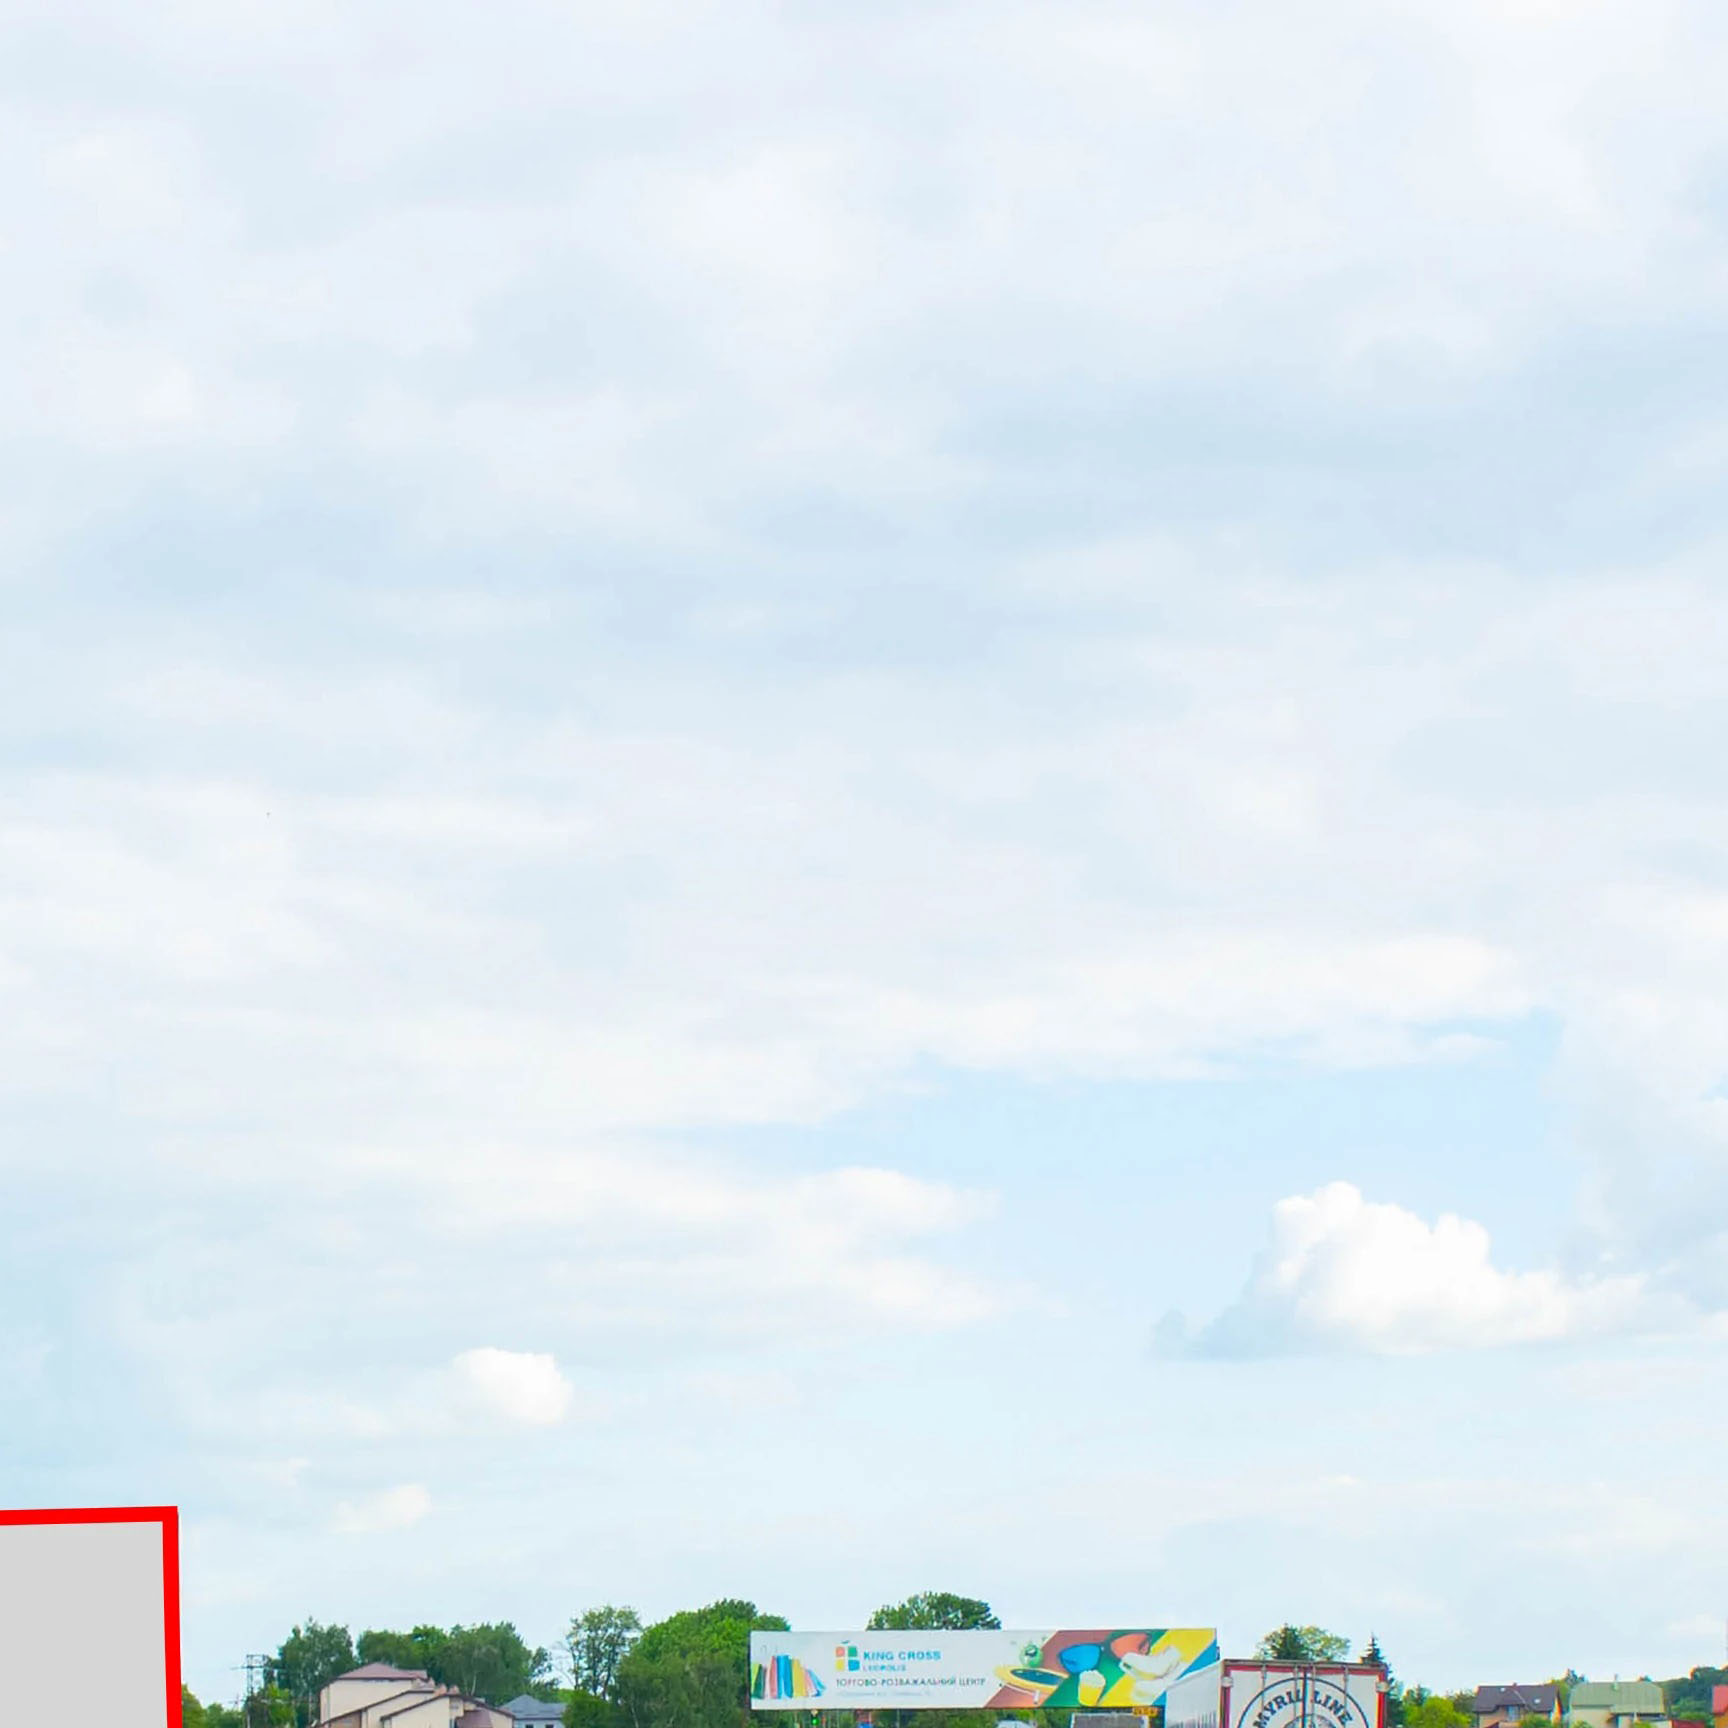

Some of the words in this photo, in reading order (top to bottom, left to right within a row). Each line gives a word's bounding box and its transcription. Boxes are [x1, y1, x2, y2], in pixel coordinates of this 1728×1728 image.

[863, 1651, 894, 1660] KING
[898, 1651, 941, 1660] CROSS
[1312, 1690, 1353, 1726] LINE
